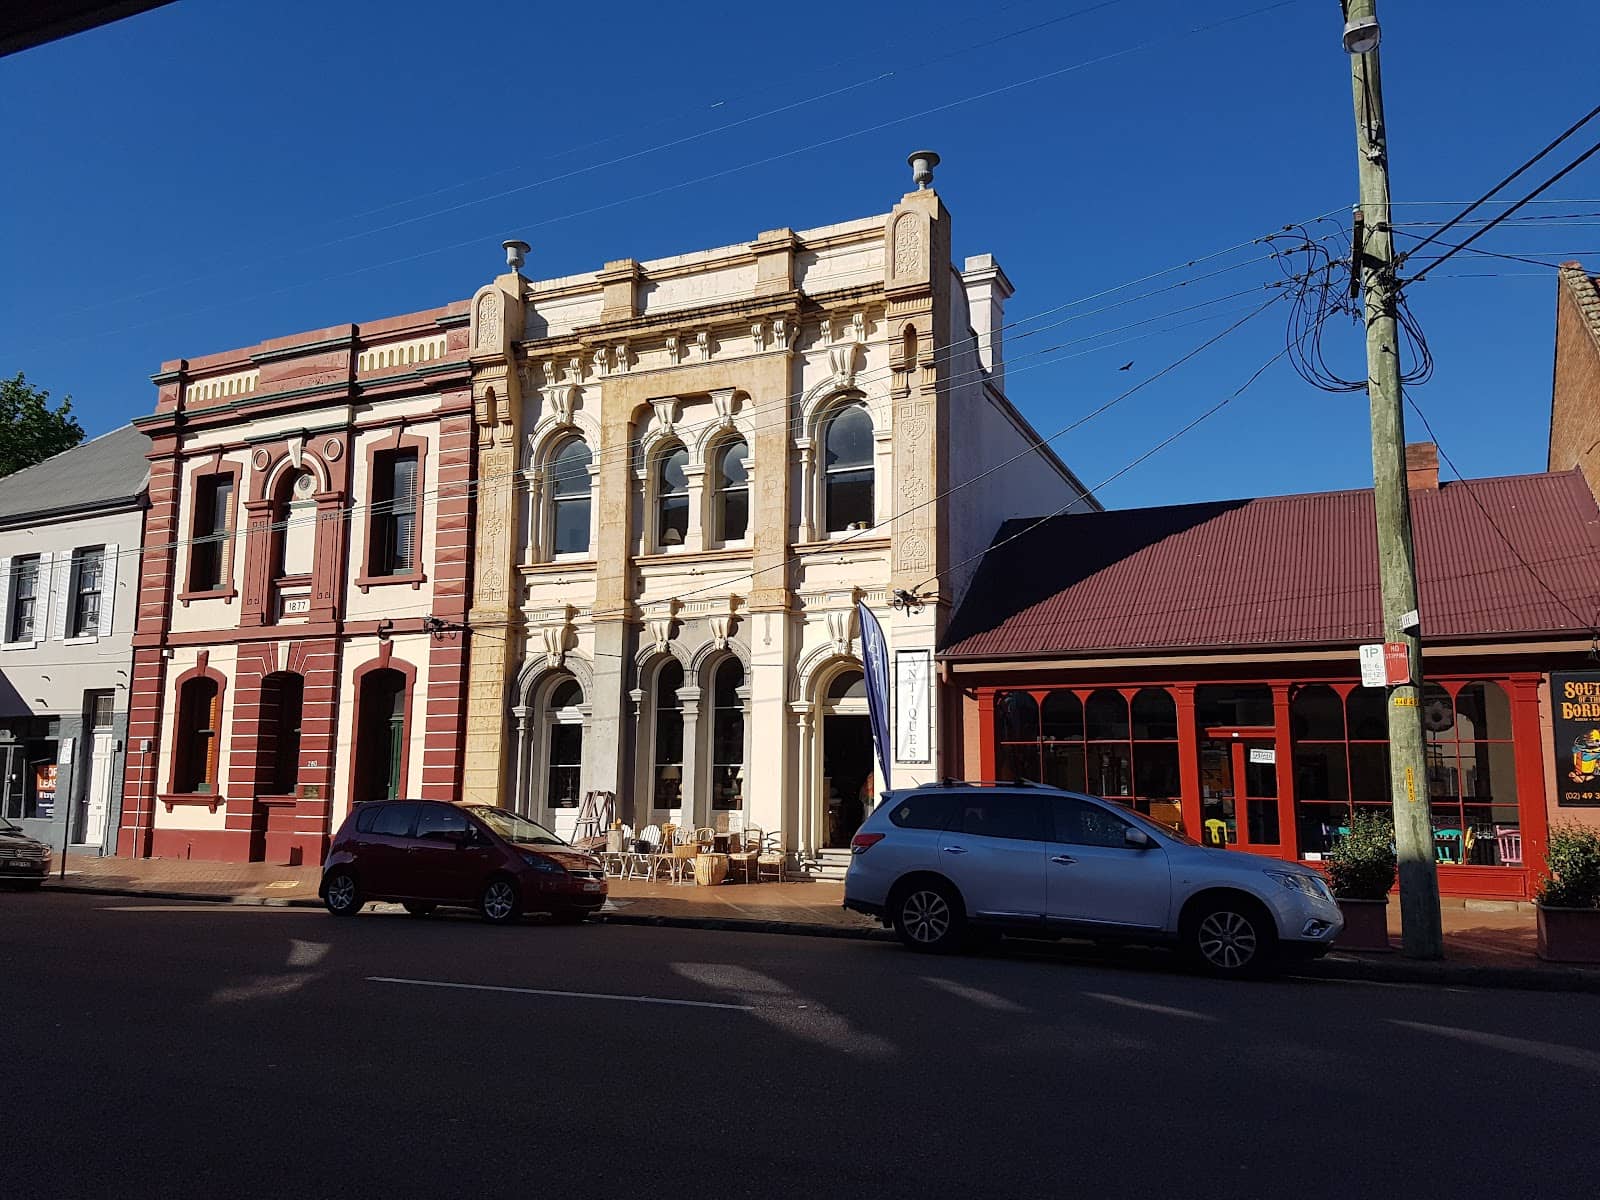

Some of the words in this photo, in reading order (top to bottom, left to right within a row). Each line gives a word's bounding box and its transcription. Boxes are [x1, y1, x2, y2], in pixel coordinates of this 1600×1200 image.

[289, 601, 306, 611] 1877
[1364, 647, 1379, 659] 1P
[908, 655, 918, 758] ANTIQUES
[1565, 791, 1580, 800] (02)
